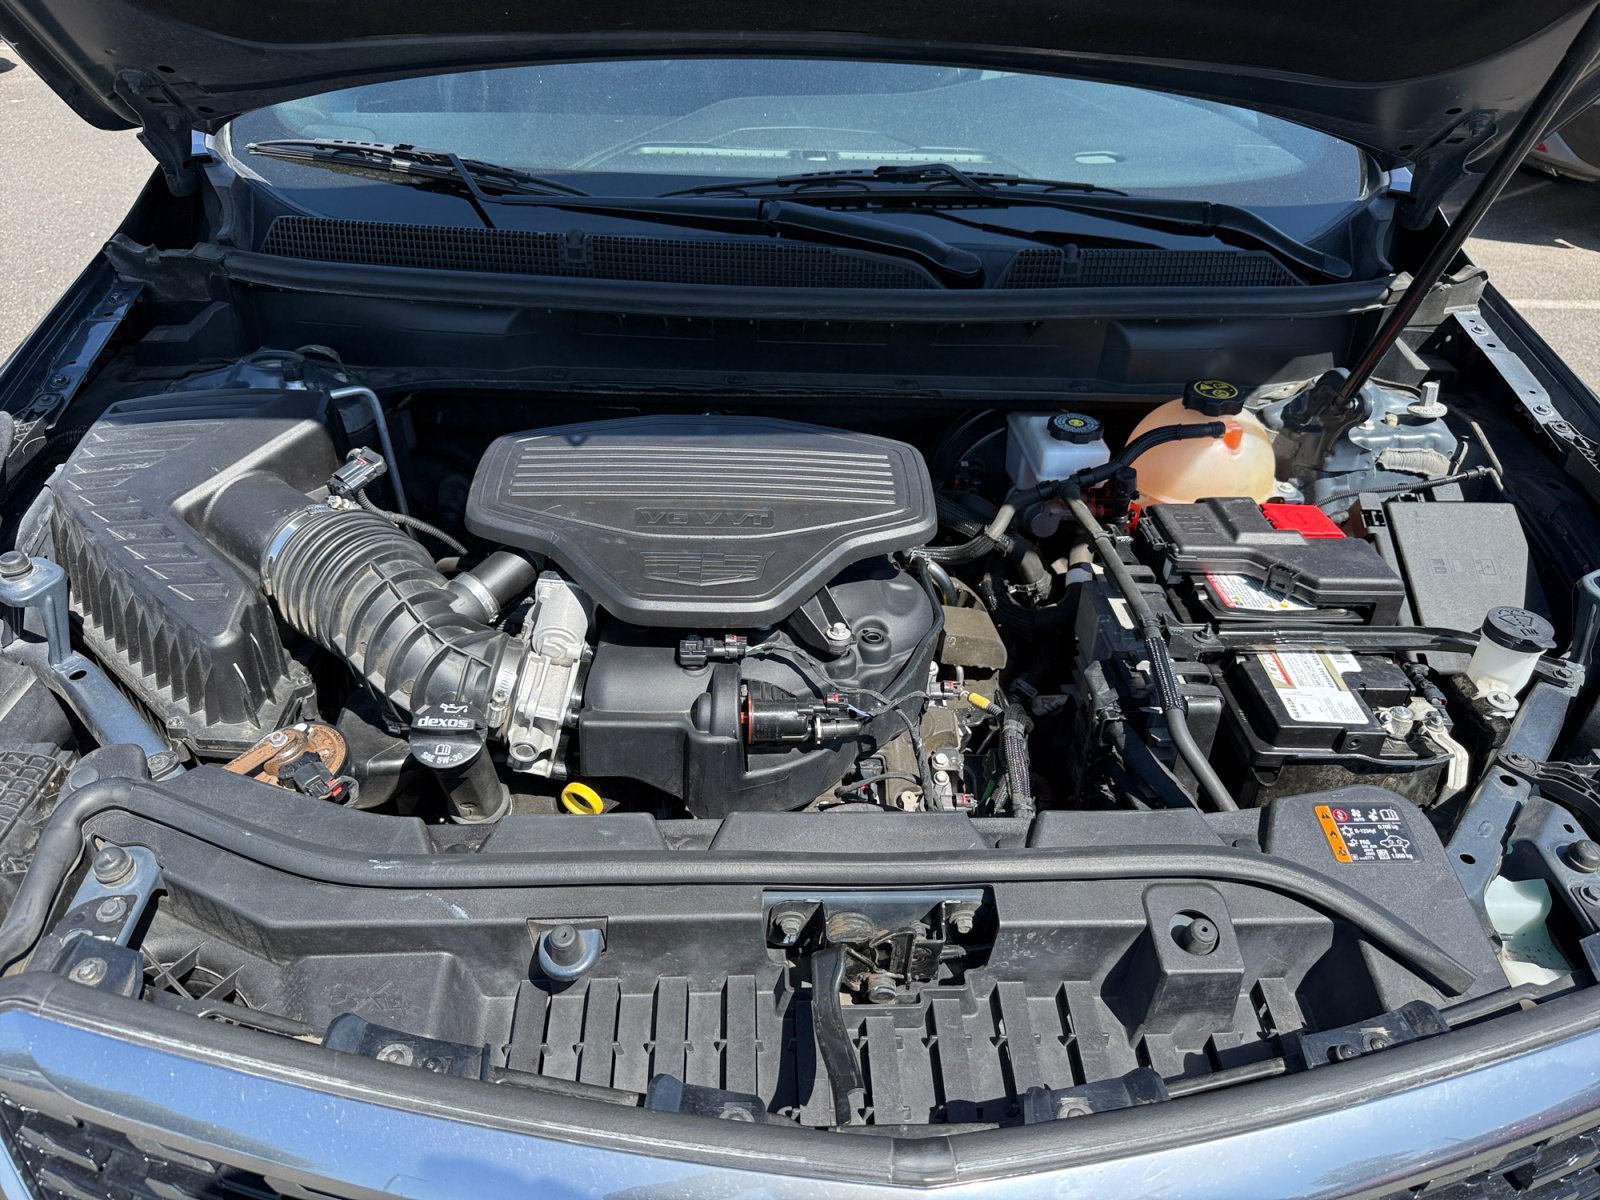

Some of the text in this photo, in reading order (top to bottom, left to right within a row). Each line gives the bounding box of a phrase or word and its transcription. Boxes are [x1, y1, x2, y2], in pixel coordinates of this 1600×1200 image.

[640, 511, 769, 526] V6 VVT
[417, 716, 468, 727] dexos
[421, 751, 463, 764] SAE 5W-30
